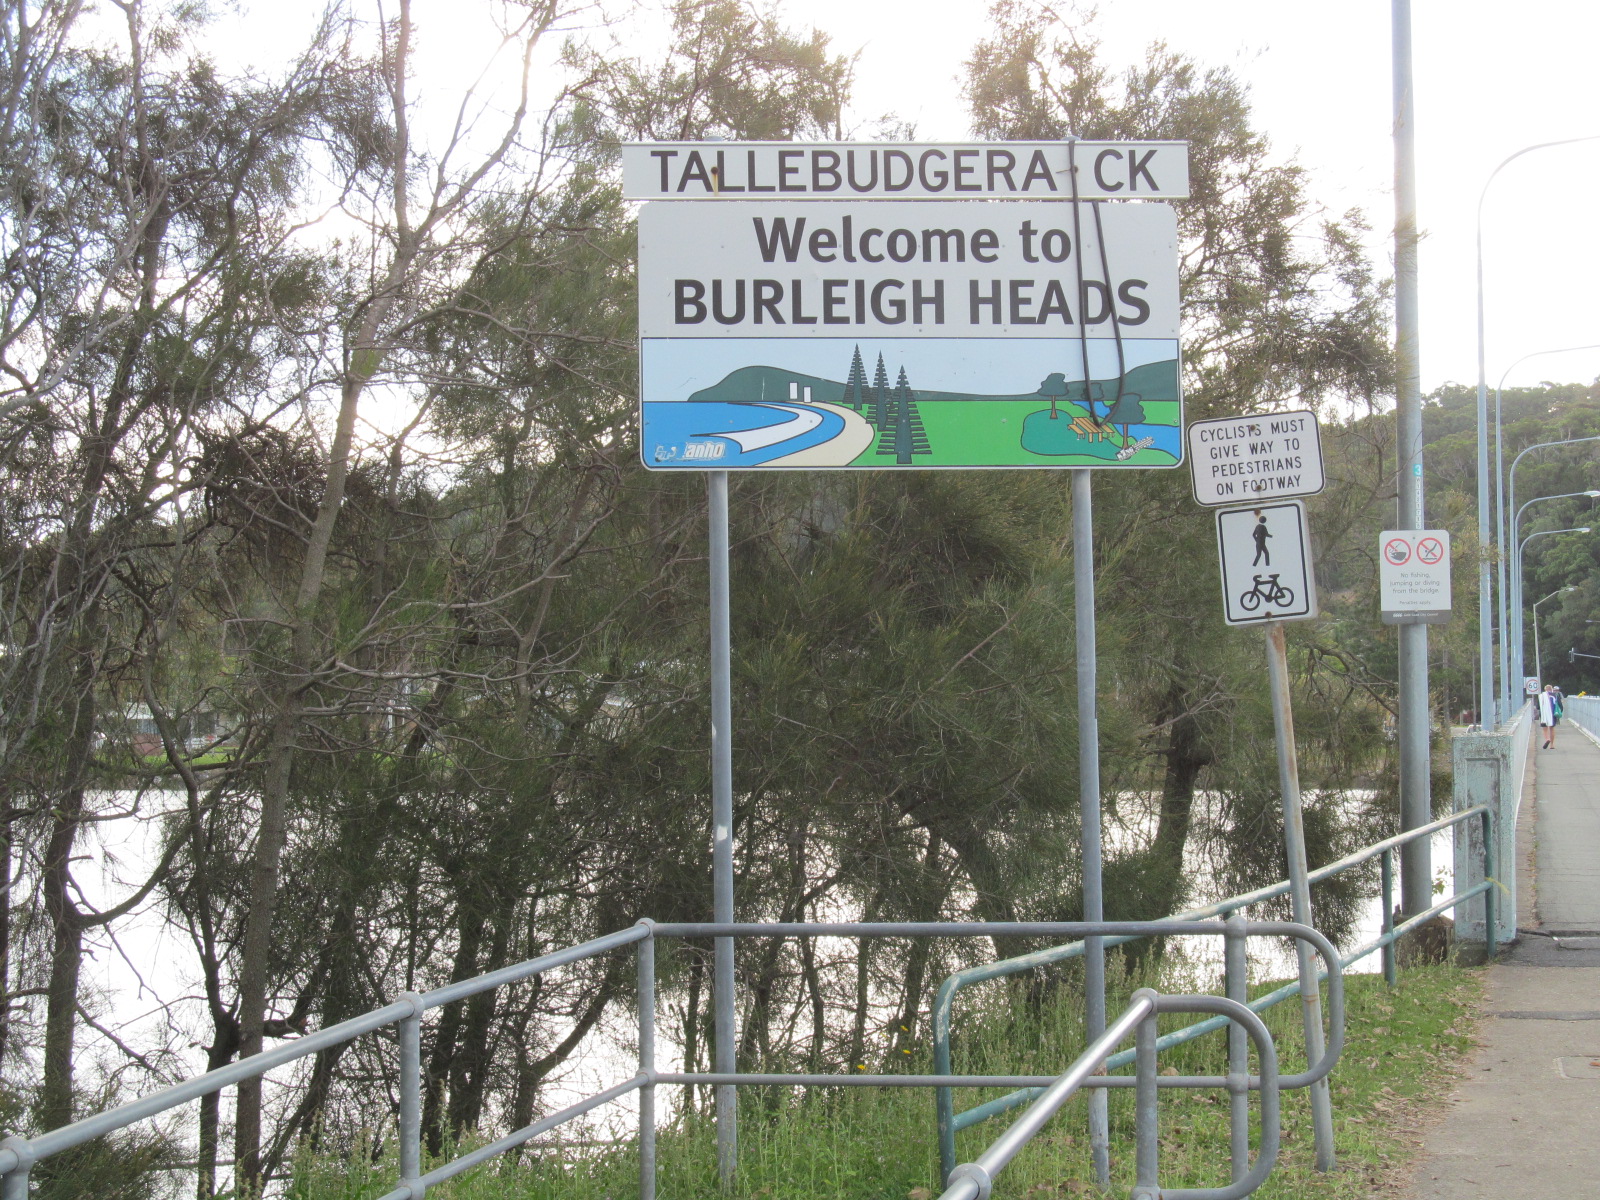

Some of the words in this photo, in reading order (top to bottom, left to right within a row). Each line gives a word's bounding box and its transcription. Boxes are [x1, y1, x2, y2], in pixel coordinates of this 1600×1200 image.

[651, 149, 1058, 193] TALLEBUDGERA
[1093, 149, 1160, 192] CK
[753, 214, 999, 263] Welcome
[1020, 219, 1071, 262] to
[674, 279, 943, 325] BURLEIGH
[970, 278, 1150, 326] HEADS
[1200, 424, 1261, 442] CYCLISTS
[1271, 419, 1304, 434] MUST
[1210, 445, 1239, 459] GIVE
[1249, 441, 1273, 455] WAY
[1284, 438, 1300, 451] TO
[1212, 456, 1302, 477] PEDESTRIANS
[1216, 482, 1234, 495] ON
[1243, 474, 1301, 493] FOOTWAY
